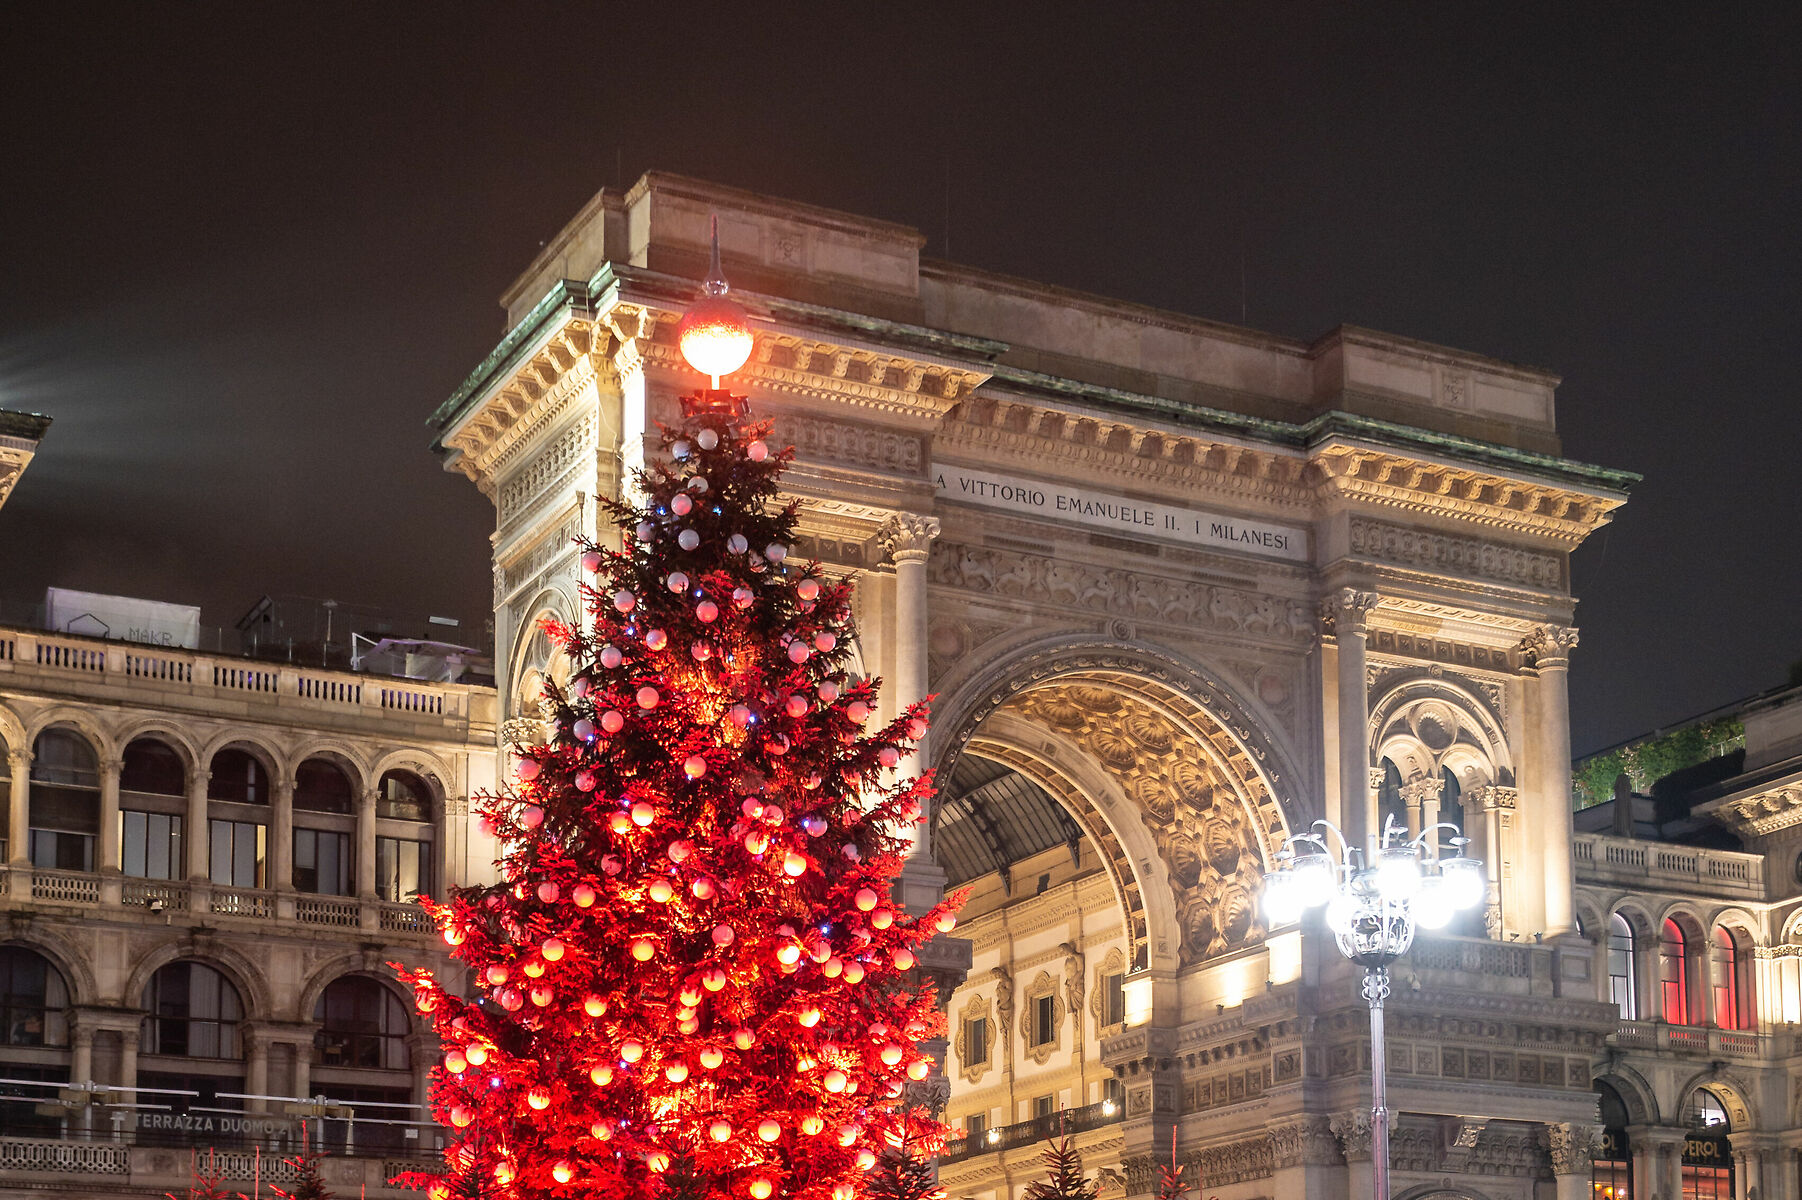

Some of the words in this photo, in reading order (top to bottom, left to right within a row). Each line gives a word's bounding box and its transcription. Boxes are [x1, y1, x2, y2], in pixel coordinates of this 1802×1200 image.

[937, 474, 946, 489] A
[959, 477, 1045, 506] VITTORIO
[1056, 495, 1155, 527] EMANUELE
[1165, 515, 1180, 531] II.
[1195, 520, 1200, 534] I
[1210, 523, 1288, 550] MILANESI
[136, 1113, 214, 1132] TERRAZZA
[221, 1118, 274, 1134] DUOMO
[1681, 1140, 1720, 1158] PEROL
